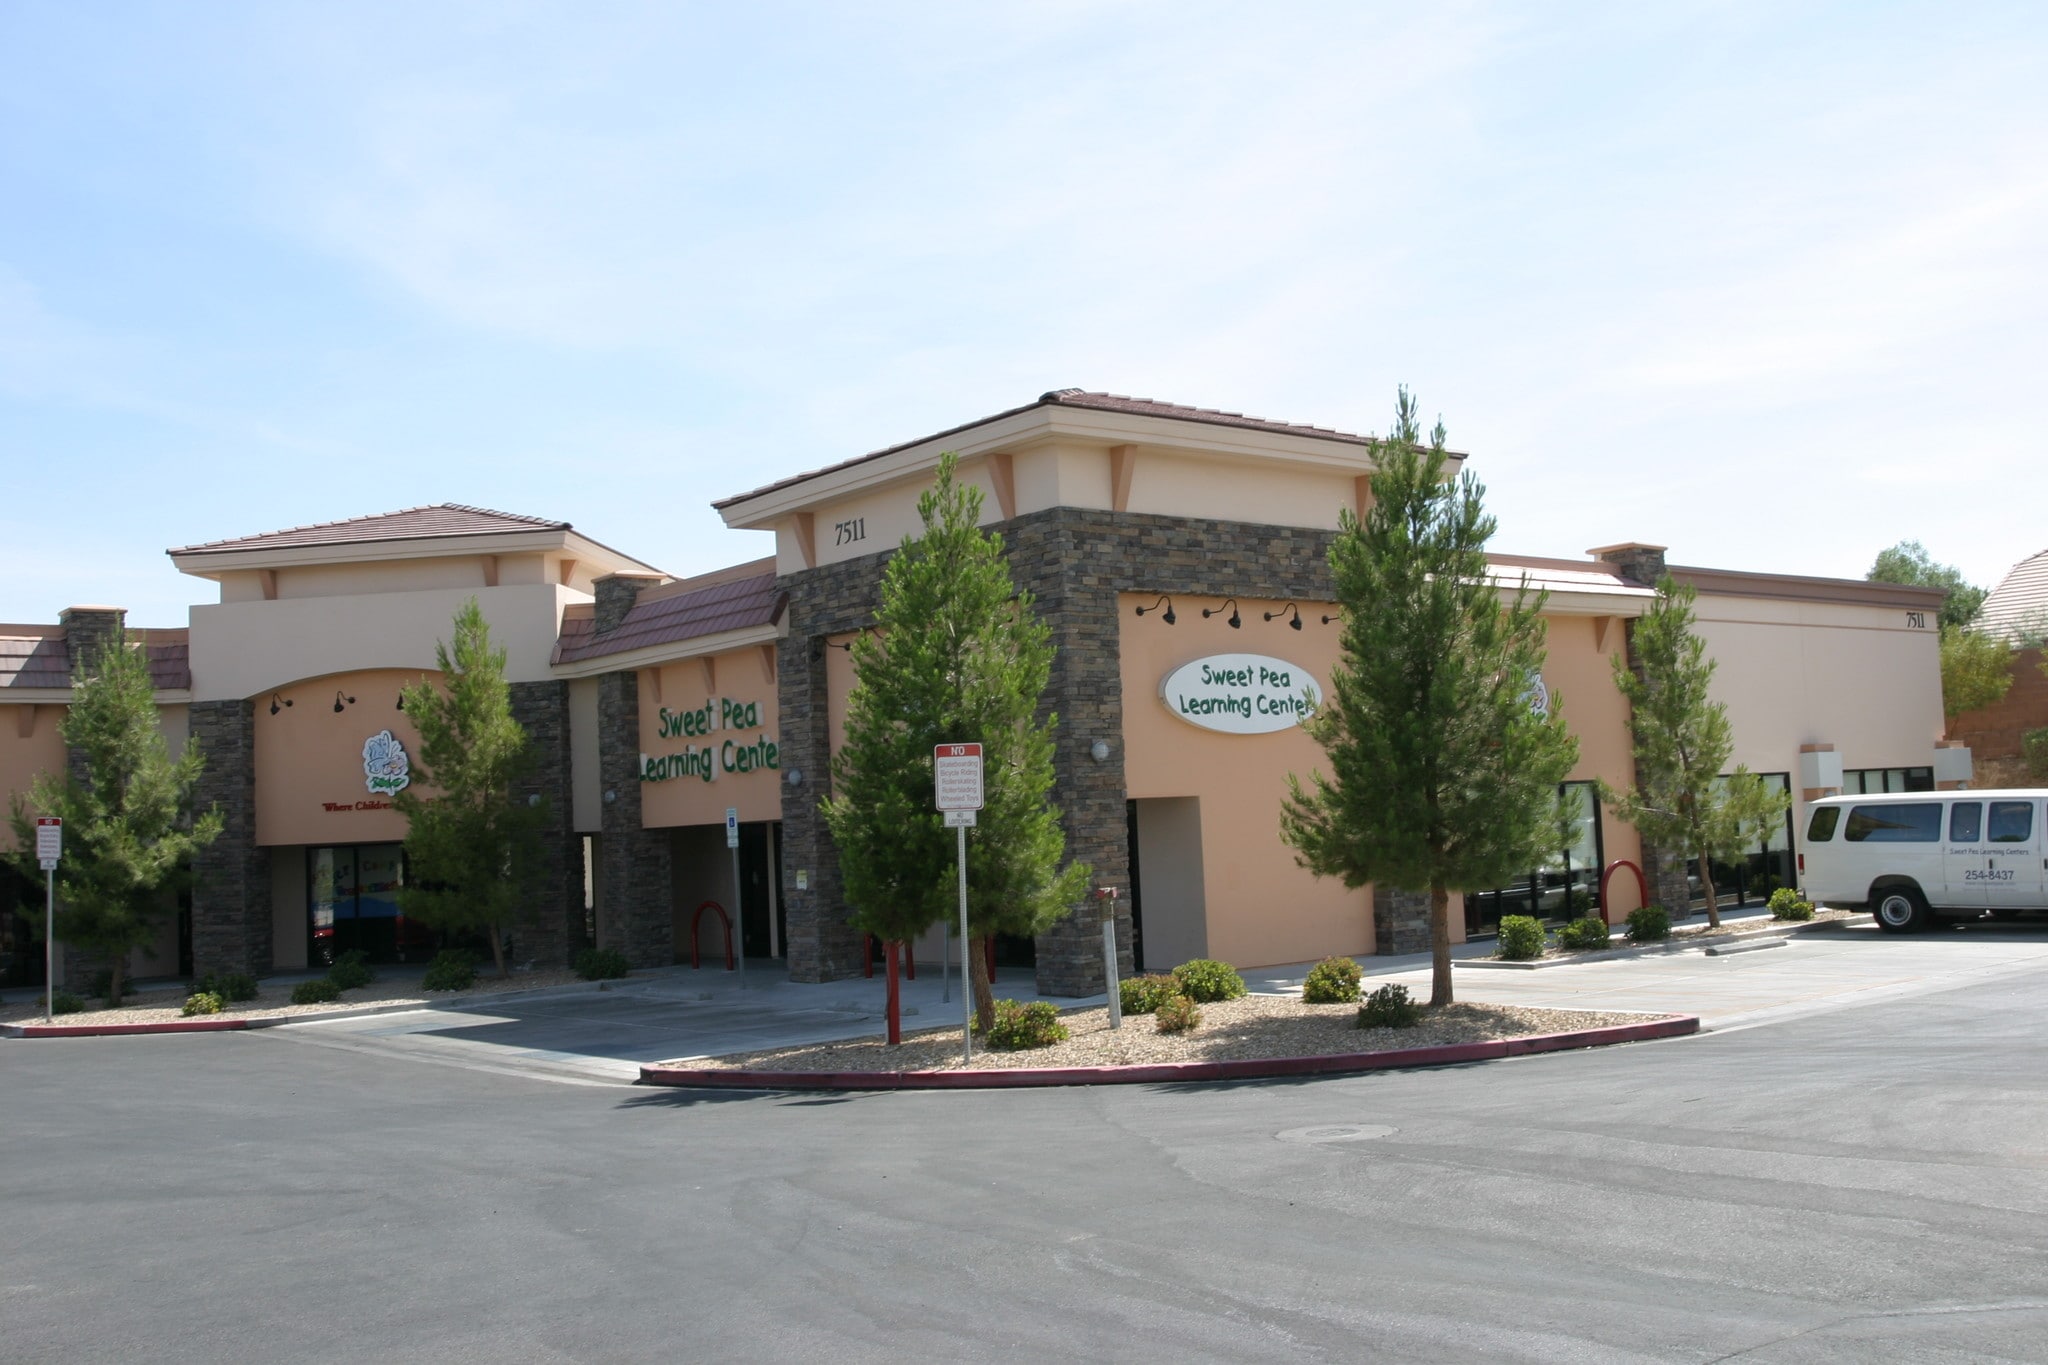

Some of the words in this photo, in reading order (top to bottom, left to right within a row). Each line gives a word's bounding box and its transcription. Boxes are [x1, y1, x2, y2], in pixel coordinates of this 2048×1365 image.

[835, 517, 866, 546] 7511
[1906, 612, 1925, 628] 7511
[1201, 664, 1254, 687] Sweet
[1260, 666, 1291, 688] Pea
[1180, 694, 1251, 718] Learning
[1257, 694, 1312, 716] Center
[659, 699, 714, 738] Sweet
[722, 697, 759, 730] Pea
[722, 734, 781, 773] Cente
[951, 746, 965, 756] NO
[940, 769, 959, 777] Bicycle
[1980, 847, 2005, 856] Learning
[1965, 870, 2014, 880] 254-8437
